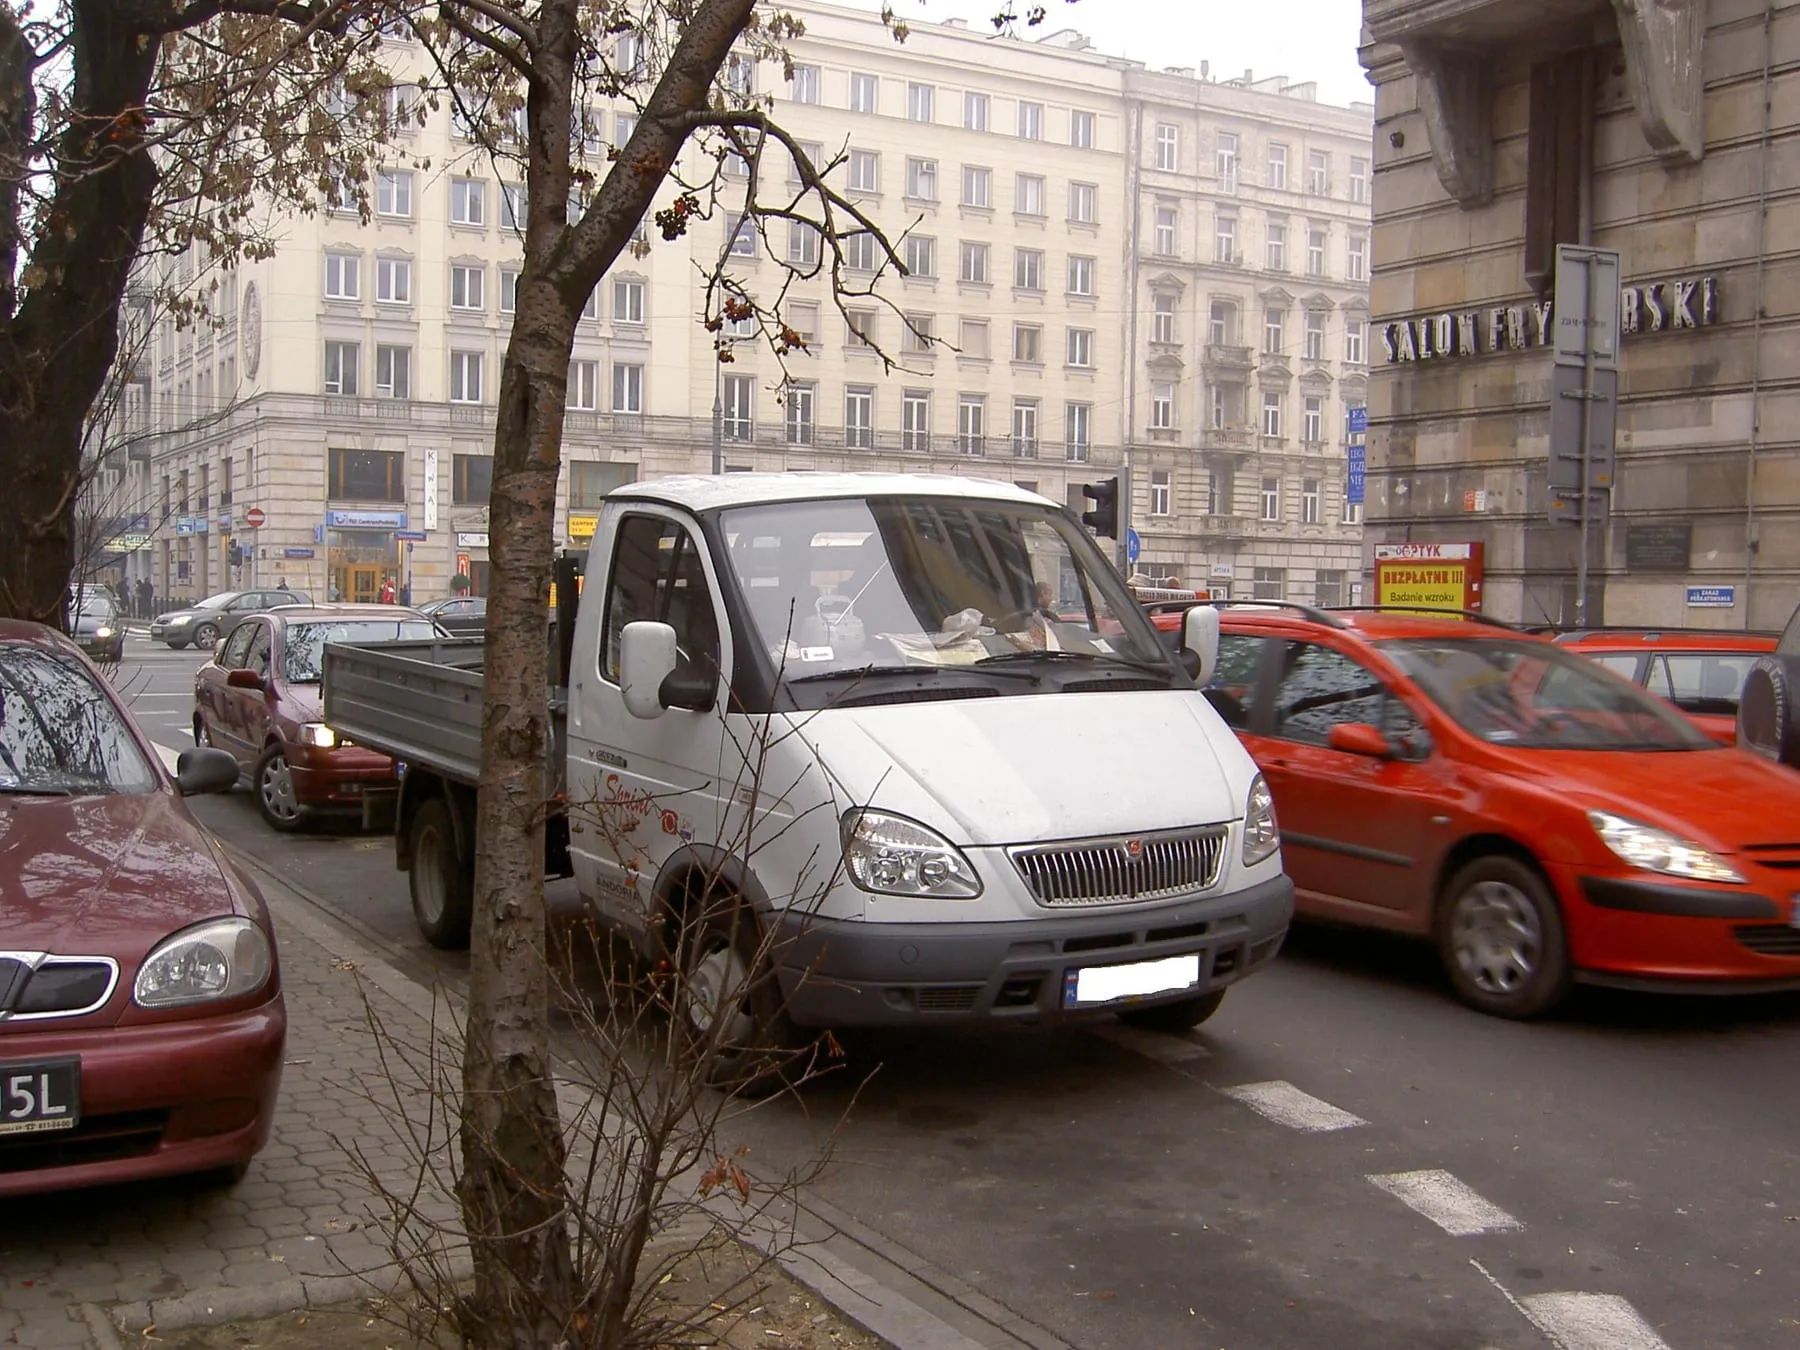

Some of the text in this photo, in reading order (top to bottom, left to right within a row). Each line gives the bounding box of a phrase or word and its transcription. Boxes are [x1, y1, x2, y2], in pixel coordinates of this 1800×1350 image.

[1382, 276, 1717, 363] SALON FRYRSKI
[1383, 570, 1448, 584] BEZPŁATNE
[1390, 592, 1454, 602] Badanie wzroku
[0, 1073, 67, 1118] 5L
